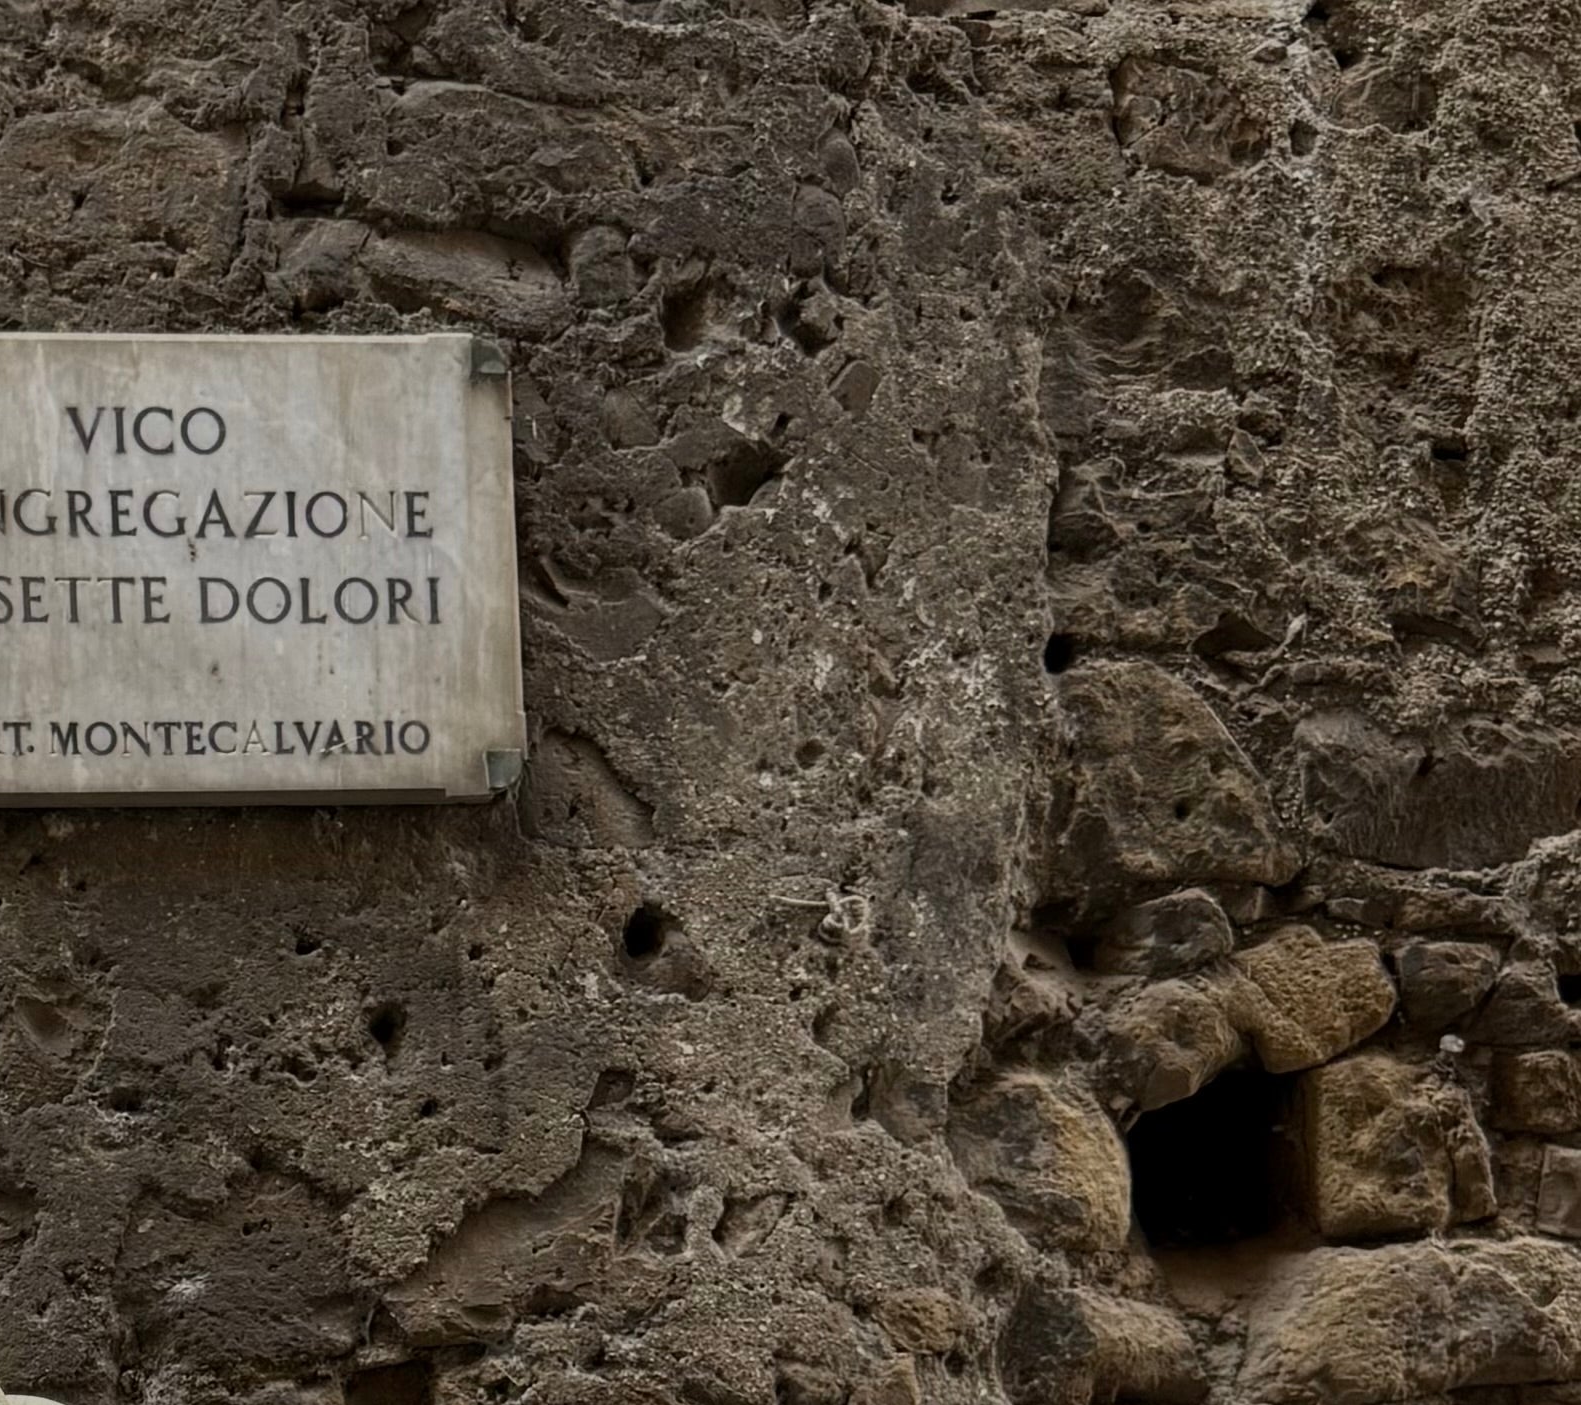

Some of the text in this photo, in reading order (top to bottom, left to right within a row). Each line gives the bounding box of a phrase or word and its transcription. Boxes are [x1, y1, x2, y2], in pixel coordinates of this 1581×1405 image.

[66, 405, 227, 456] VICO
[199, 576, 441, 625] DOLORI
[49, 719, 431, 757] MONTECALVARIO
